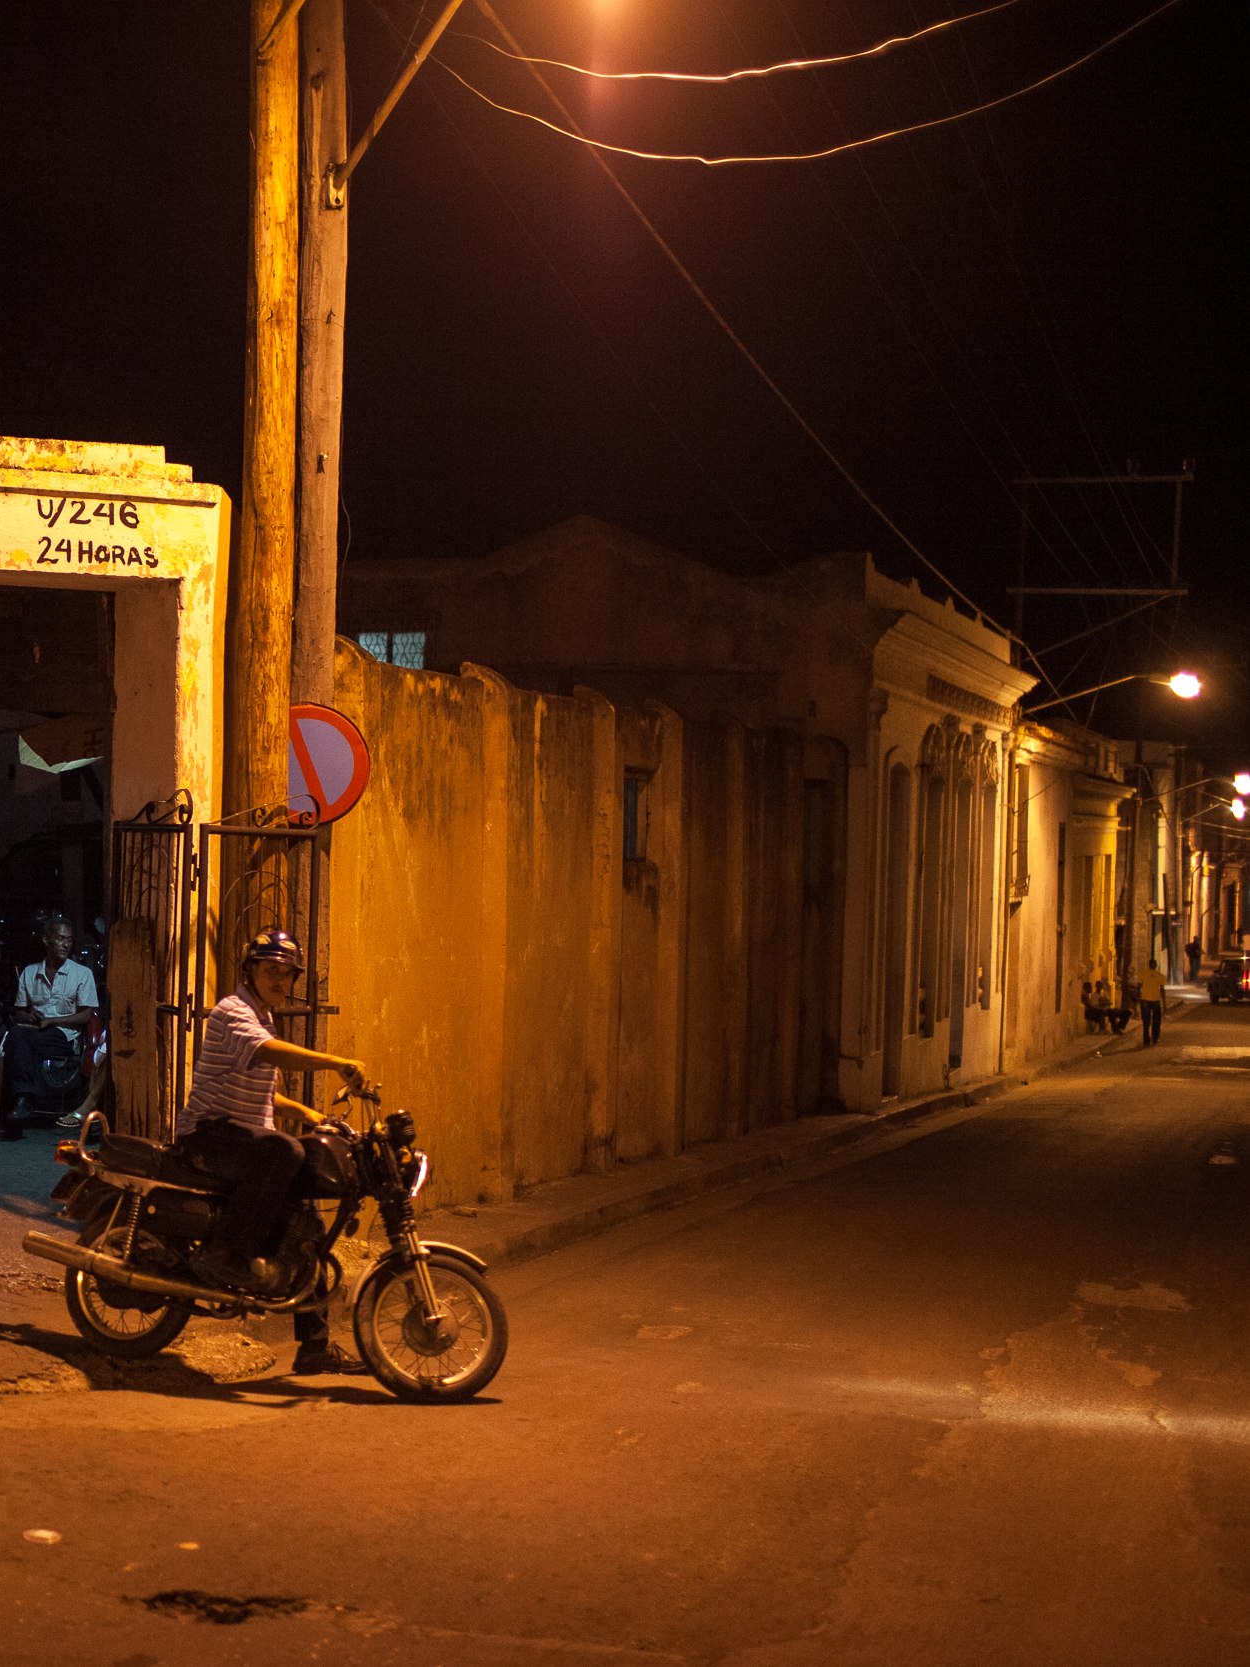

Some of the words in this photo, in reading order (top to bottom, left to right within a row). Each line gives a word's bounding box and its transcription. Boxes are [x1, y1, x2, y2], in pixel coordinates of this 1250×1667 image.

[36, 497, 140, 529] U/246
[36, 536, 72, 564] 24
[78, 539, 159, 569] HORAS
